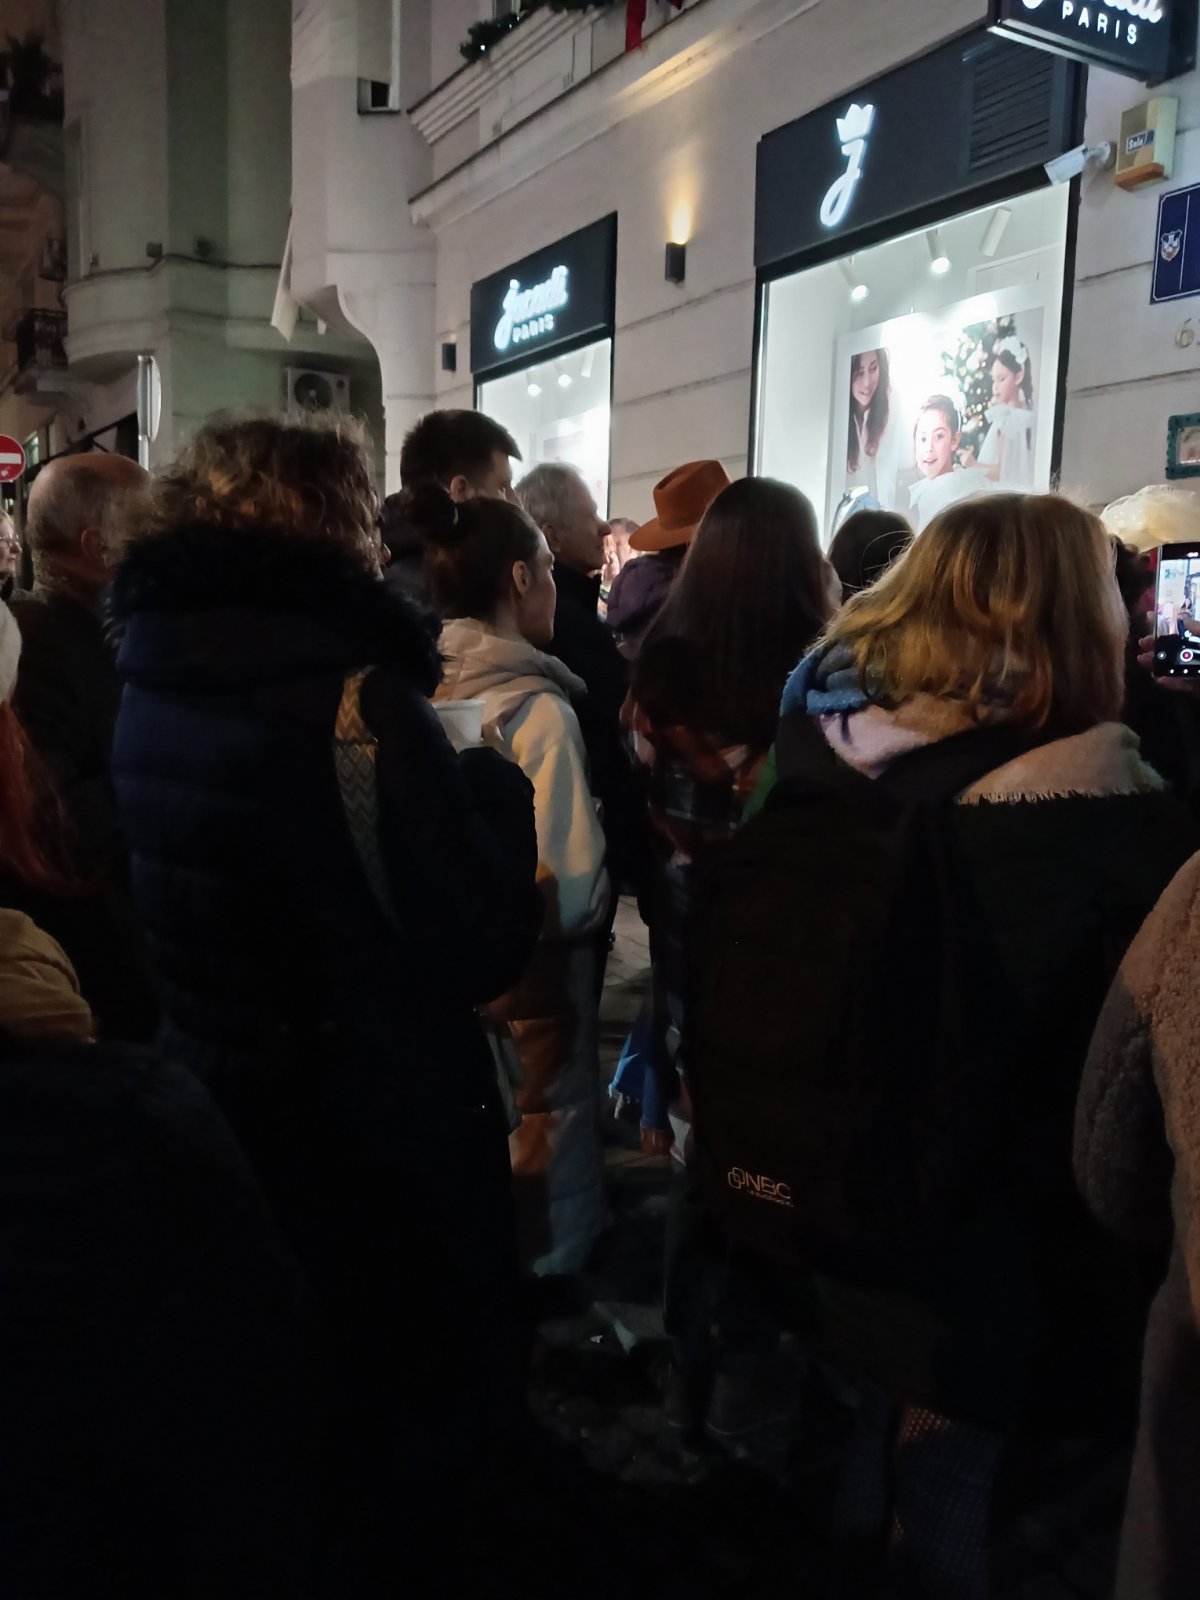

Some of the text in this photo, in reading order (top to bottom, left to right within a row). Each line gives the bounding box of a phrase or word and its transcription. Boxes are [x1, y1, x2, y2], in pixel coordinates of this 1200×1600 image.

[1062, 0, 1137, 44] PARIS
[512, 313, 554, 342] PARIS
[745, 1170, 792, 1200] NBC
